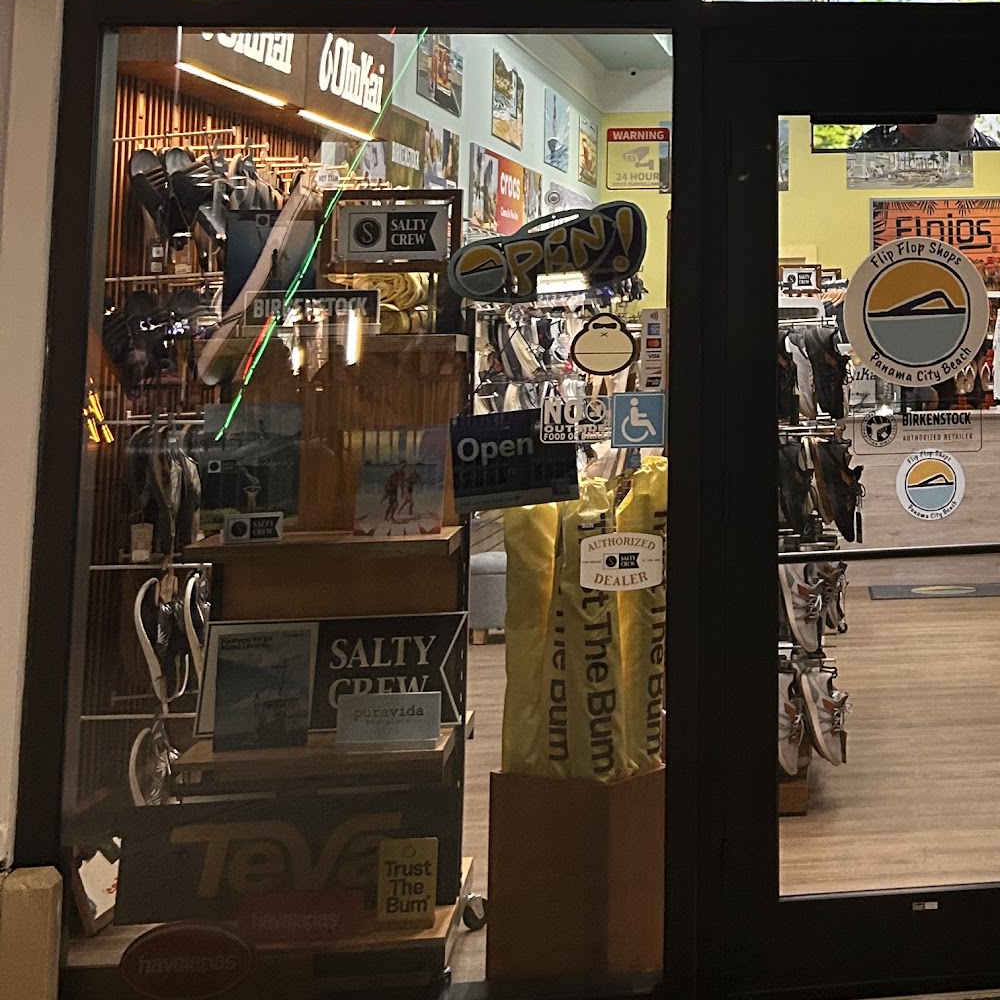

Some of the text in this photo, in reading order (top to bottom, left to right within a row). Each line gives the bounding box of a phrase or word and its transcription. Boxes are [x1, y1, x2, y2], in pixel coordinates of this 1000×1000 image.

[613, 131, 664, 140] WARNING
[616, 172, 628, 181] 24
[500, 172, 521, 201] crocs
[391, 218, 429, 232] SALTY
[391, 233, 427, 246] CREW
[870, 241, 962, 268] Flip Flop Shops
[870, 351, 912, 382] Panama
[917, 368, 941, 382] City
[941, 346, 972, 374] Beach
[544, 399, 583, 425] NO
[902, 412, 972, 426] BIRKENSTOCK
[544, 432, 566, 440] FOOD
[457, 437, 534, 466] Open
[930, 511, 943, 519] City
[943, 501, 958, 514] Beach
[588, 536, 656, 552] AUTHORIZED
[594, 571, 649, 586] DEALER
[329, 635, 437, 670] SALTY
[584, 611, 614, 684] The
[354, 705, 424, 721] puravida
[586, 688, 616, 773] Bum
[384, 859, 432, 877] Trust
[388, 878, 425, 896] The
